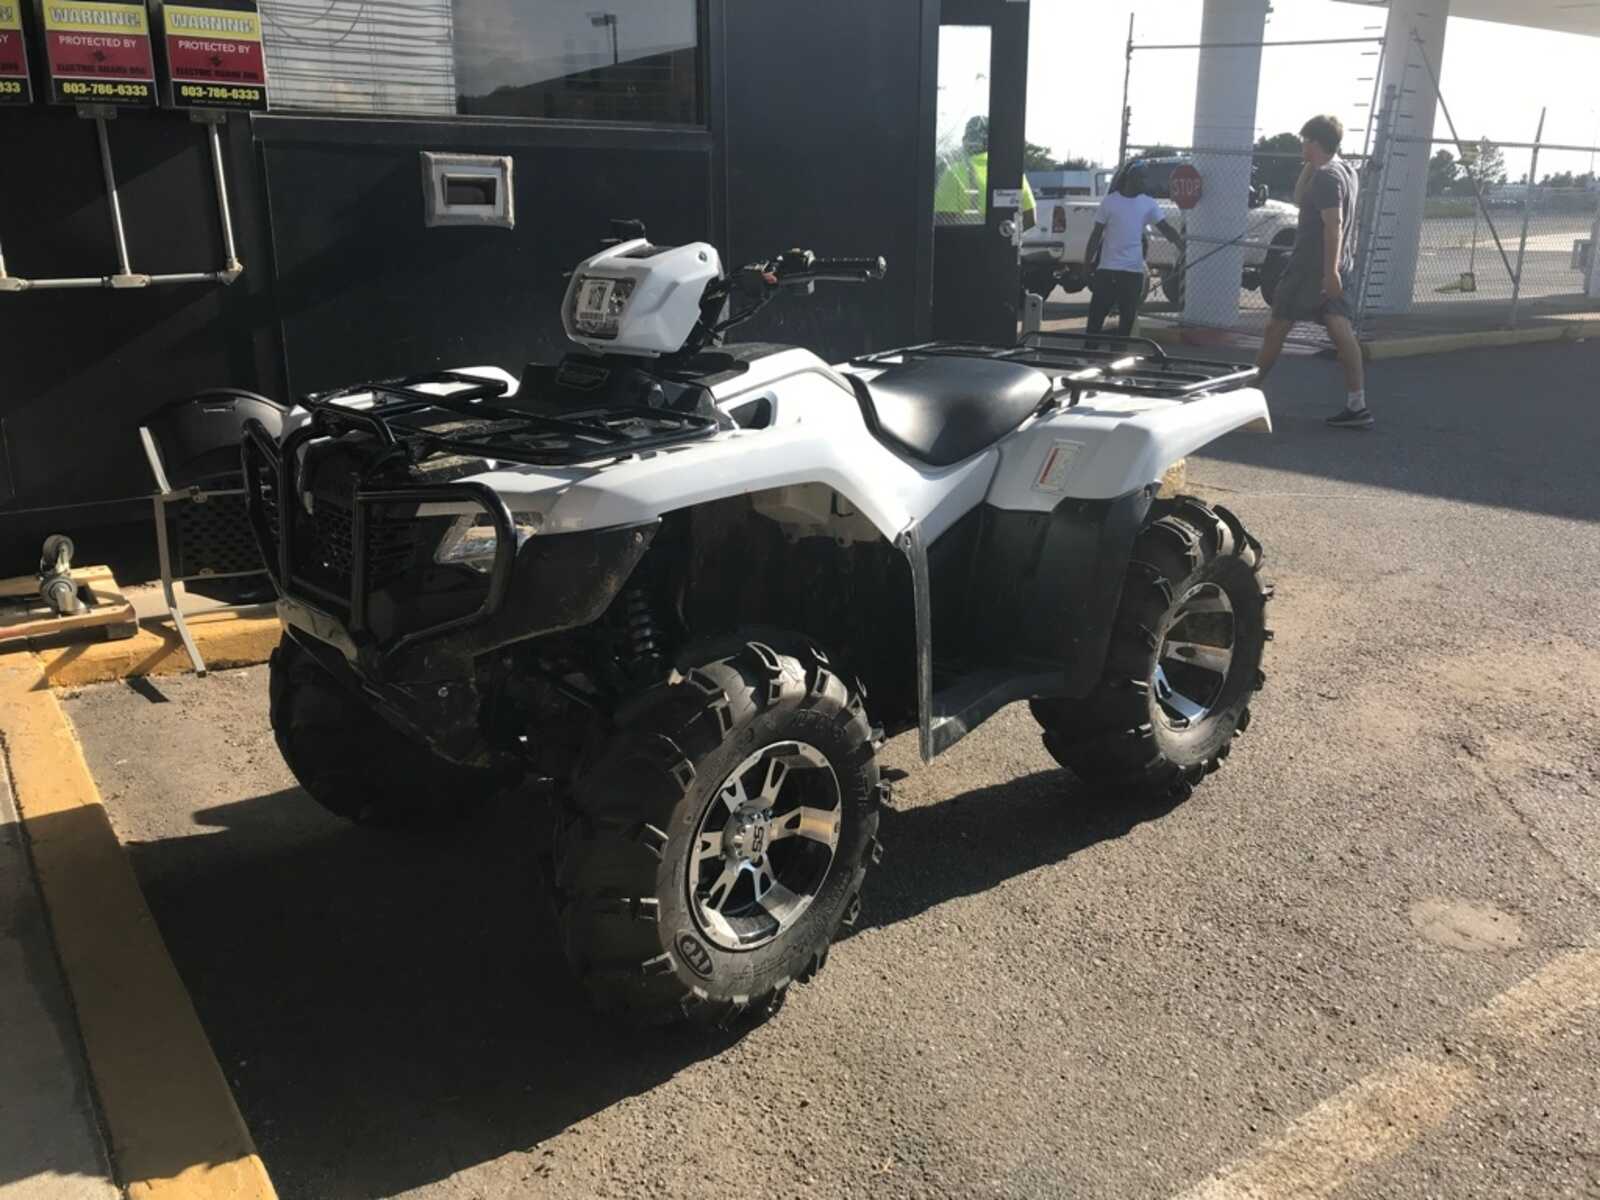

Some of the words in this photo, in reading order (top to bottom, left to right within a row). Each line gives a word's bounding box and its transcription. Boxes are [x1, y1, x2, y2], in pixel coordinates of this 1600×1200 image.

[58, 35, 121, 47] PROTECTED
[123, 38, 137, 48] BY
[178, 40, 235, 52] PROTECTED
[238, 45, 250, 53] BY
[1173, 177, 1201, 196] STOP
